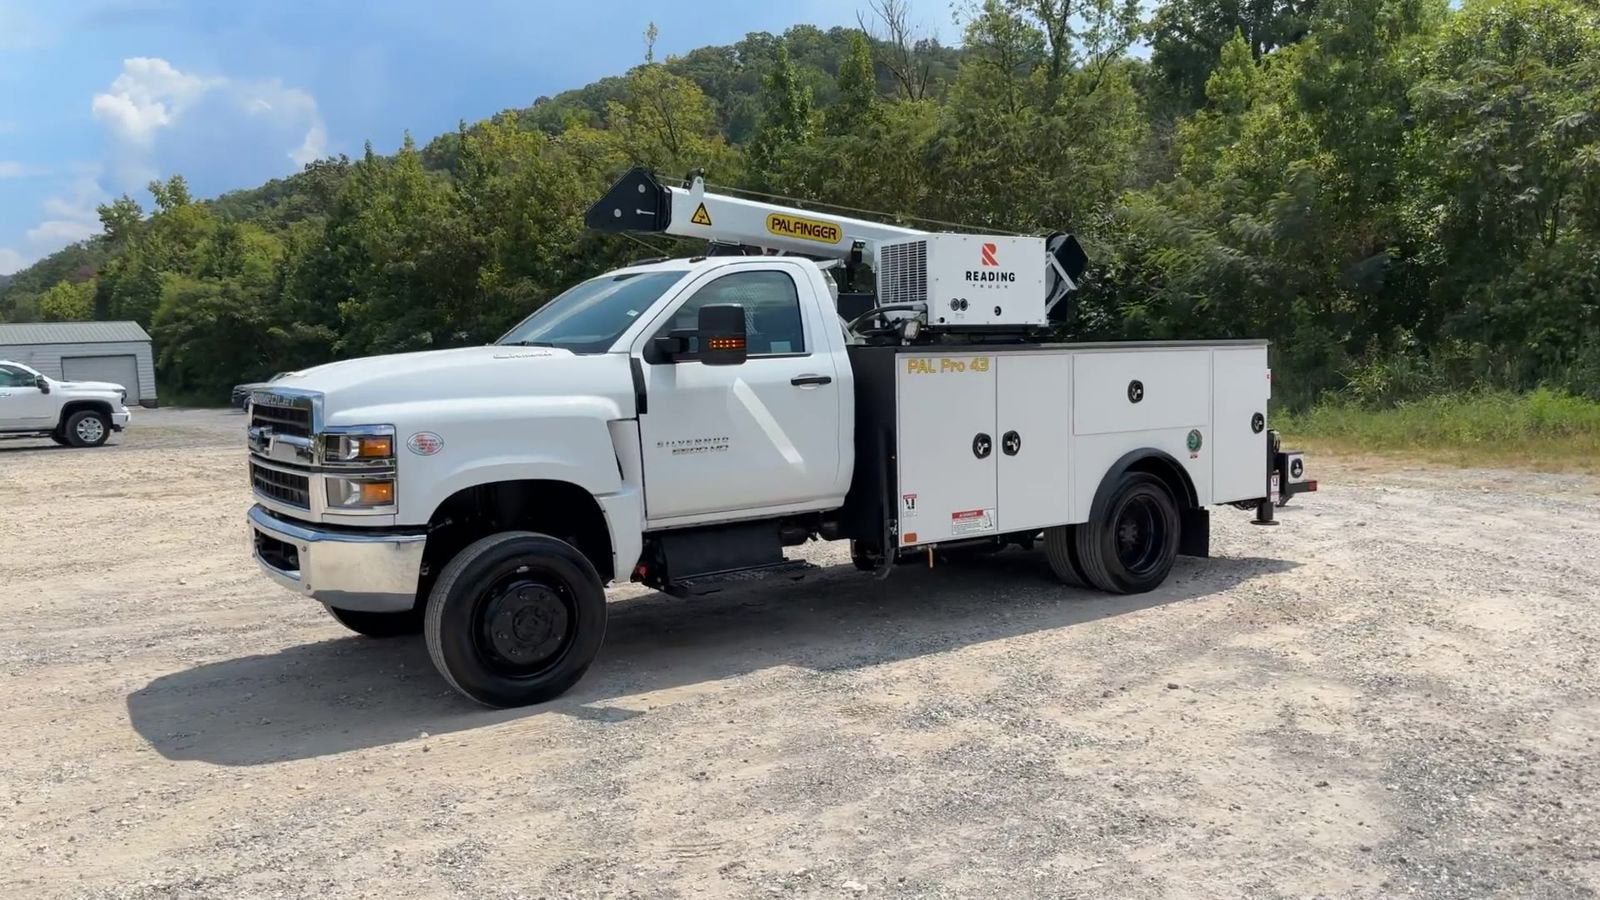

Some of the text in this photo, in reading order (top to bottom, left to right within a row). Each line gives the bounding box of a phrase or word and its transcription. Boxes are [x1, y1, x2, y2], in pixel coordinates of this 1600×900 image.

[771, 217, 837, 240] PALFINGER
[965, 271, 1016, 282] READING
[908, 357, 989, 374] PAL Pro 43
